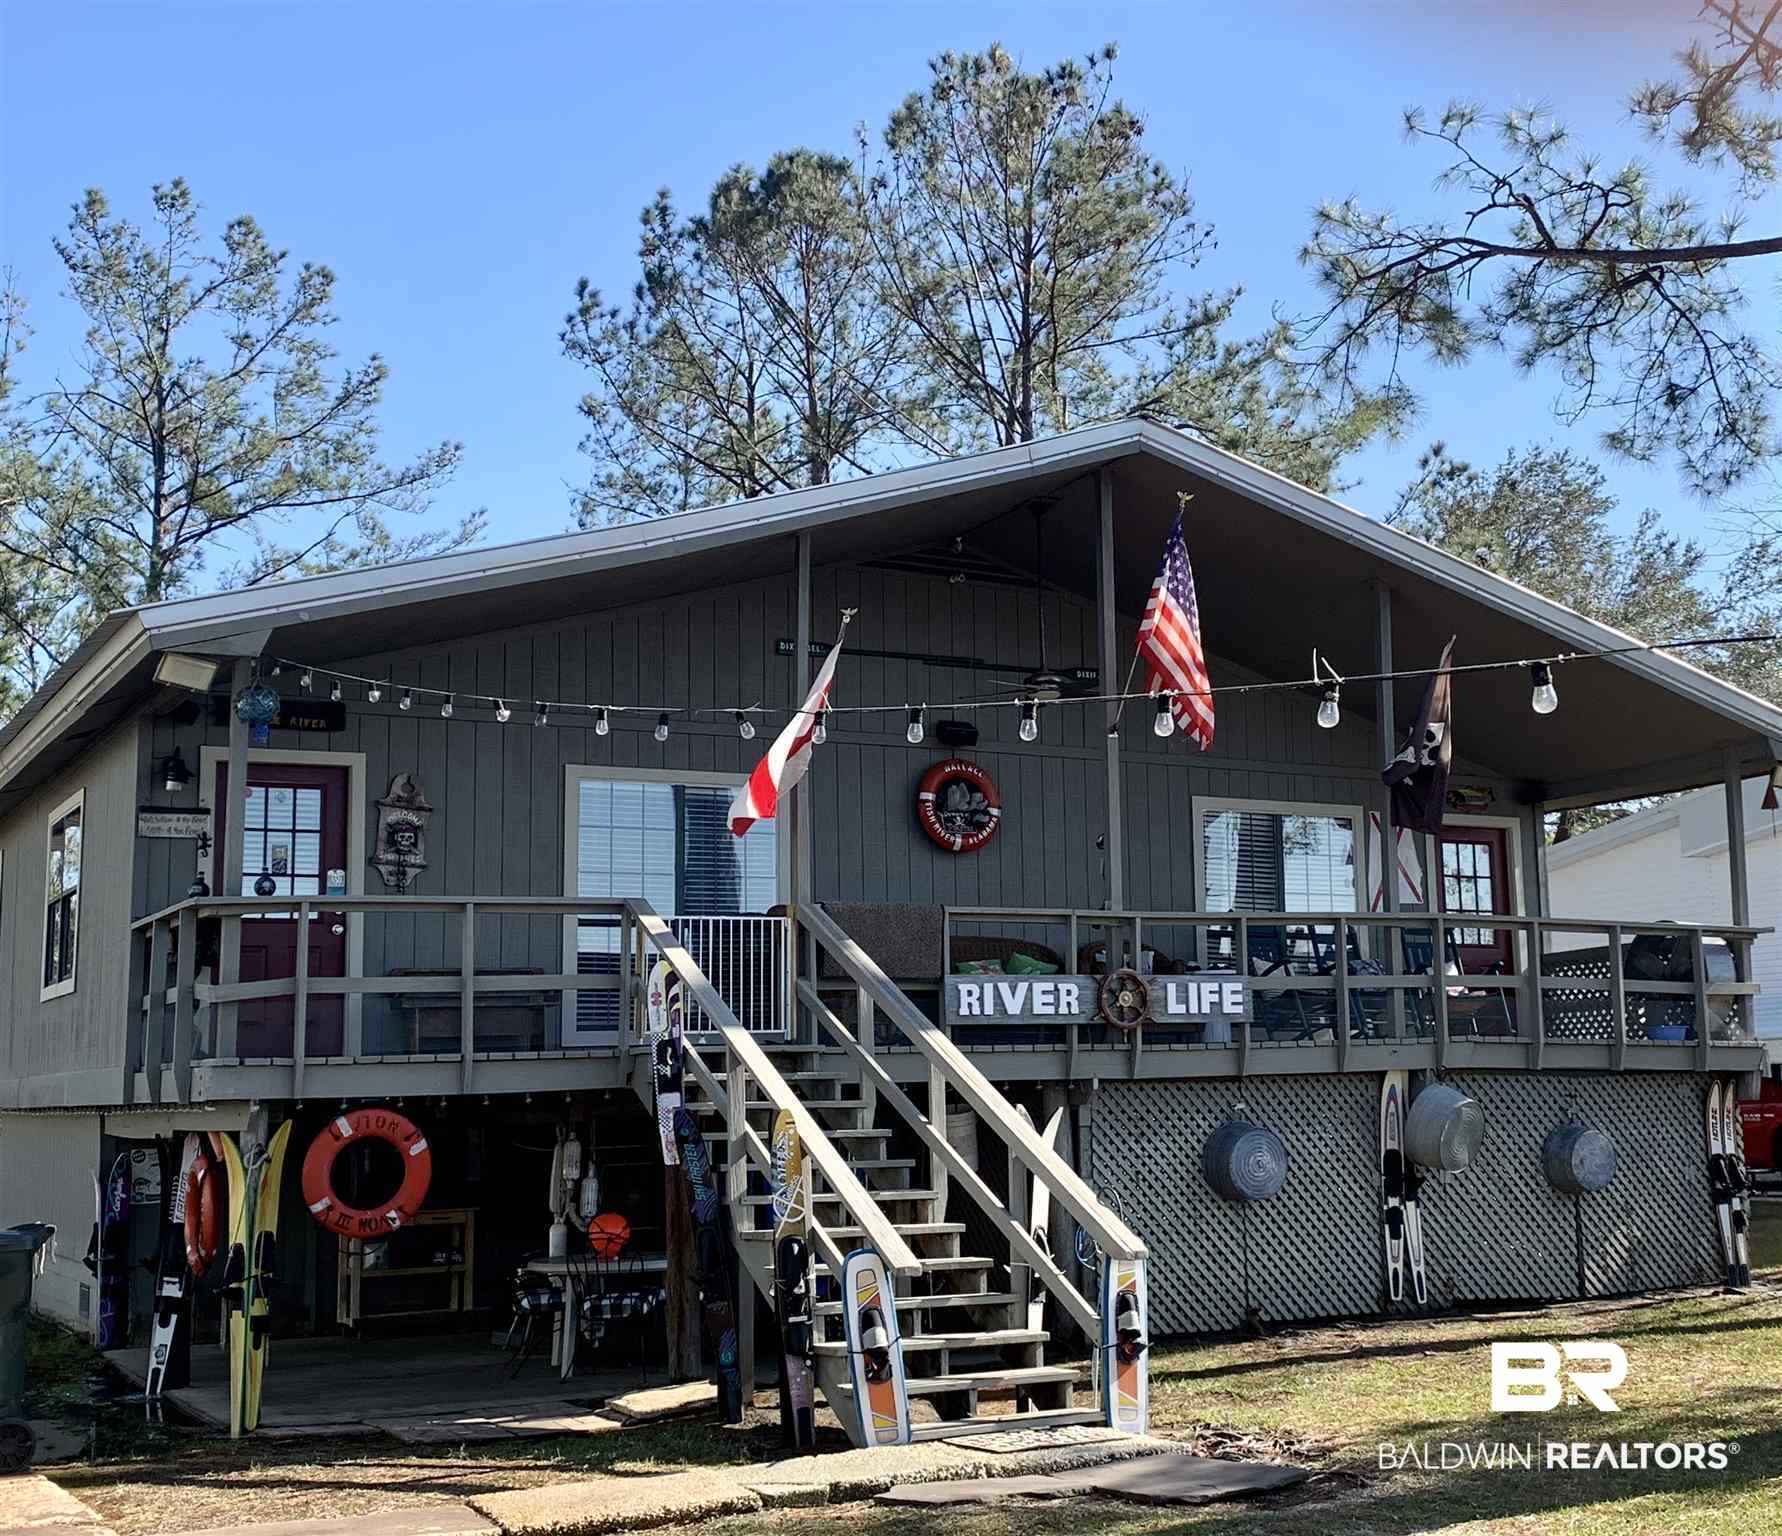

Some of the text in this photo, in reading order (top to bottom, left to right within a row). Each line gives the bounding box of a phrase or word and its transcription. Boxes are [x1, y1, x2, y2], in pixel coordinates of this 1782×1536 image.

[779, 641, 799, 652] DIX
[957, 981, 1244, 1016] RIVER LIFE
